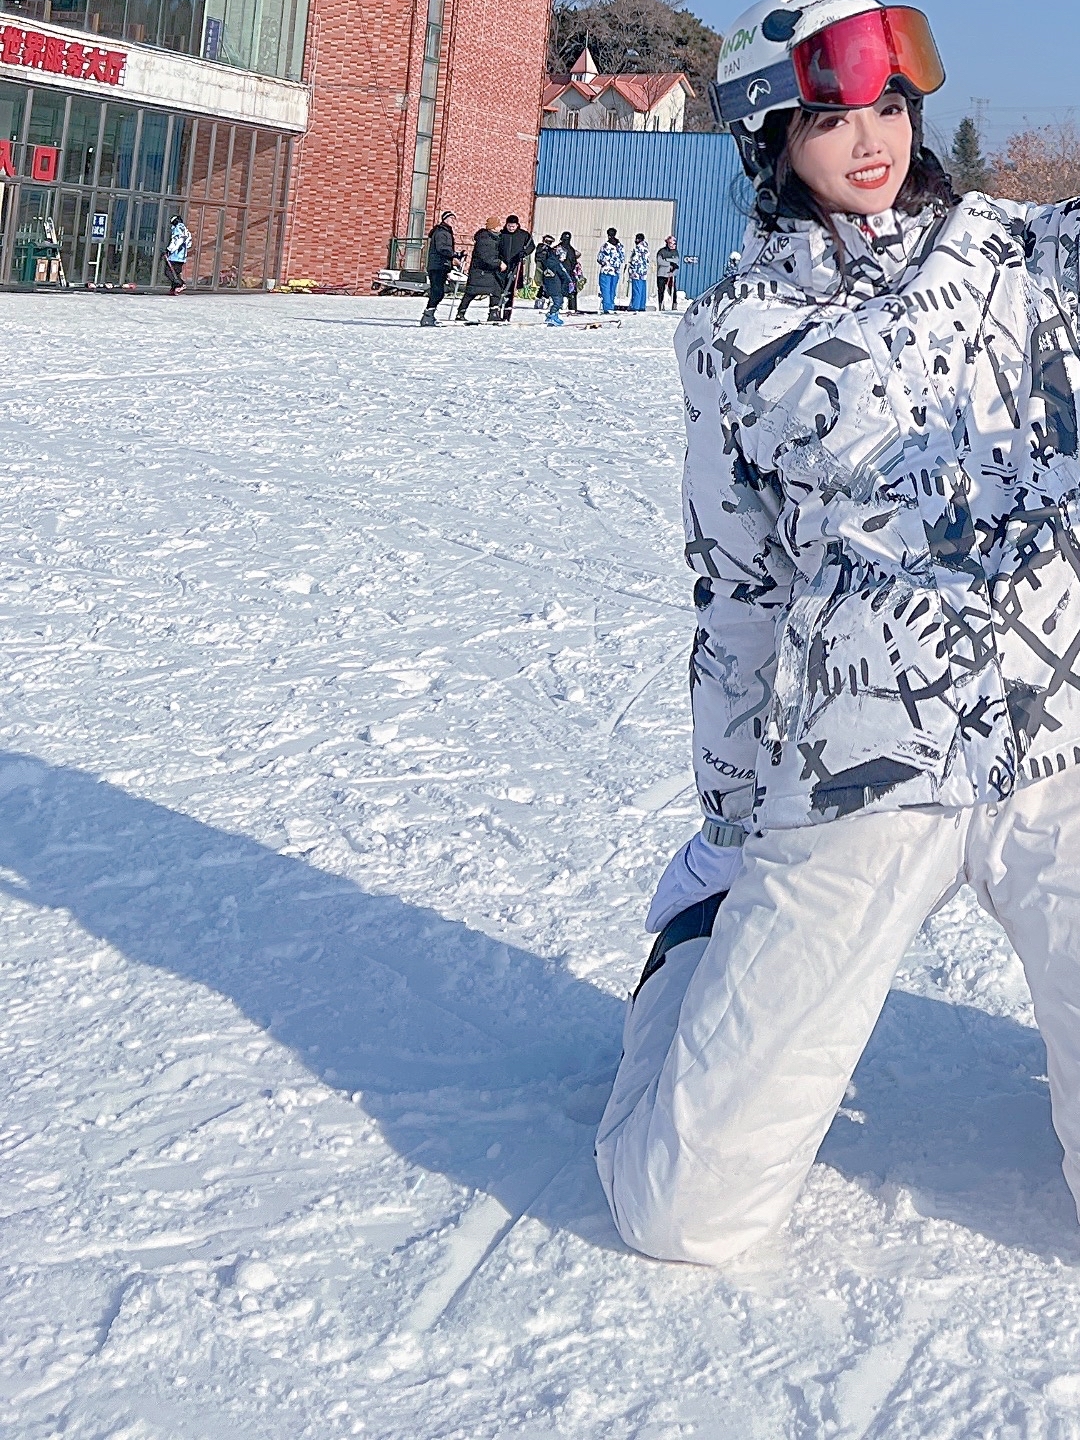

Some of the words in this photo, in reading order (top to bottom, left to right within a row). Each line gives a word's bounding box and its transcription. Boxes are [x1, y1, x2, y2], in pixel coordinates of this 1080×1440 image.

[0, 25, 127, 86] 世界服务大厅
